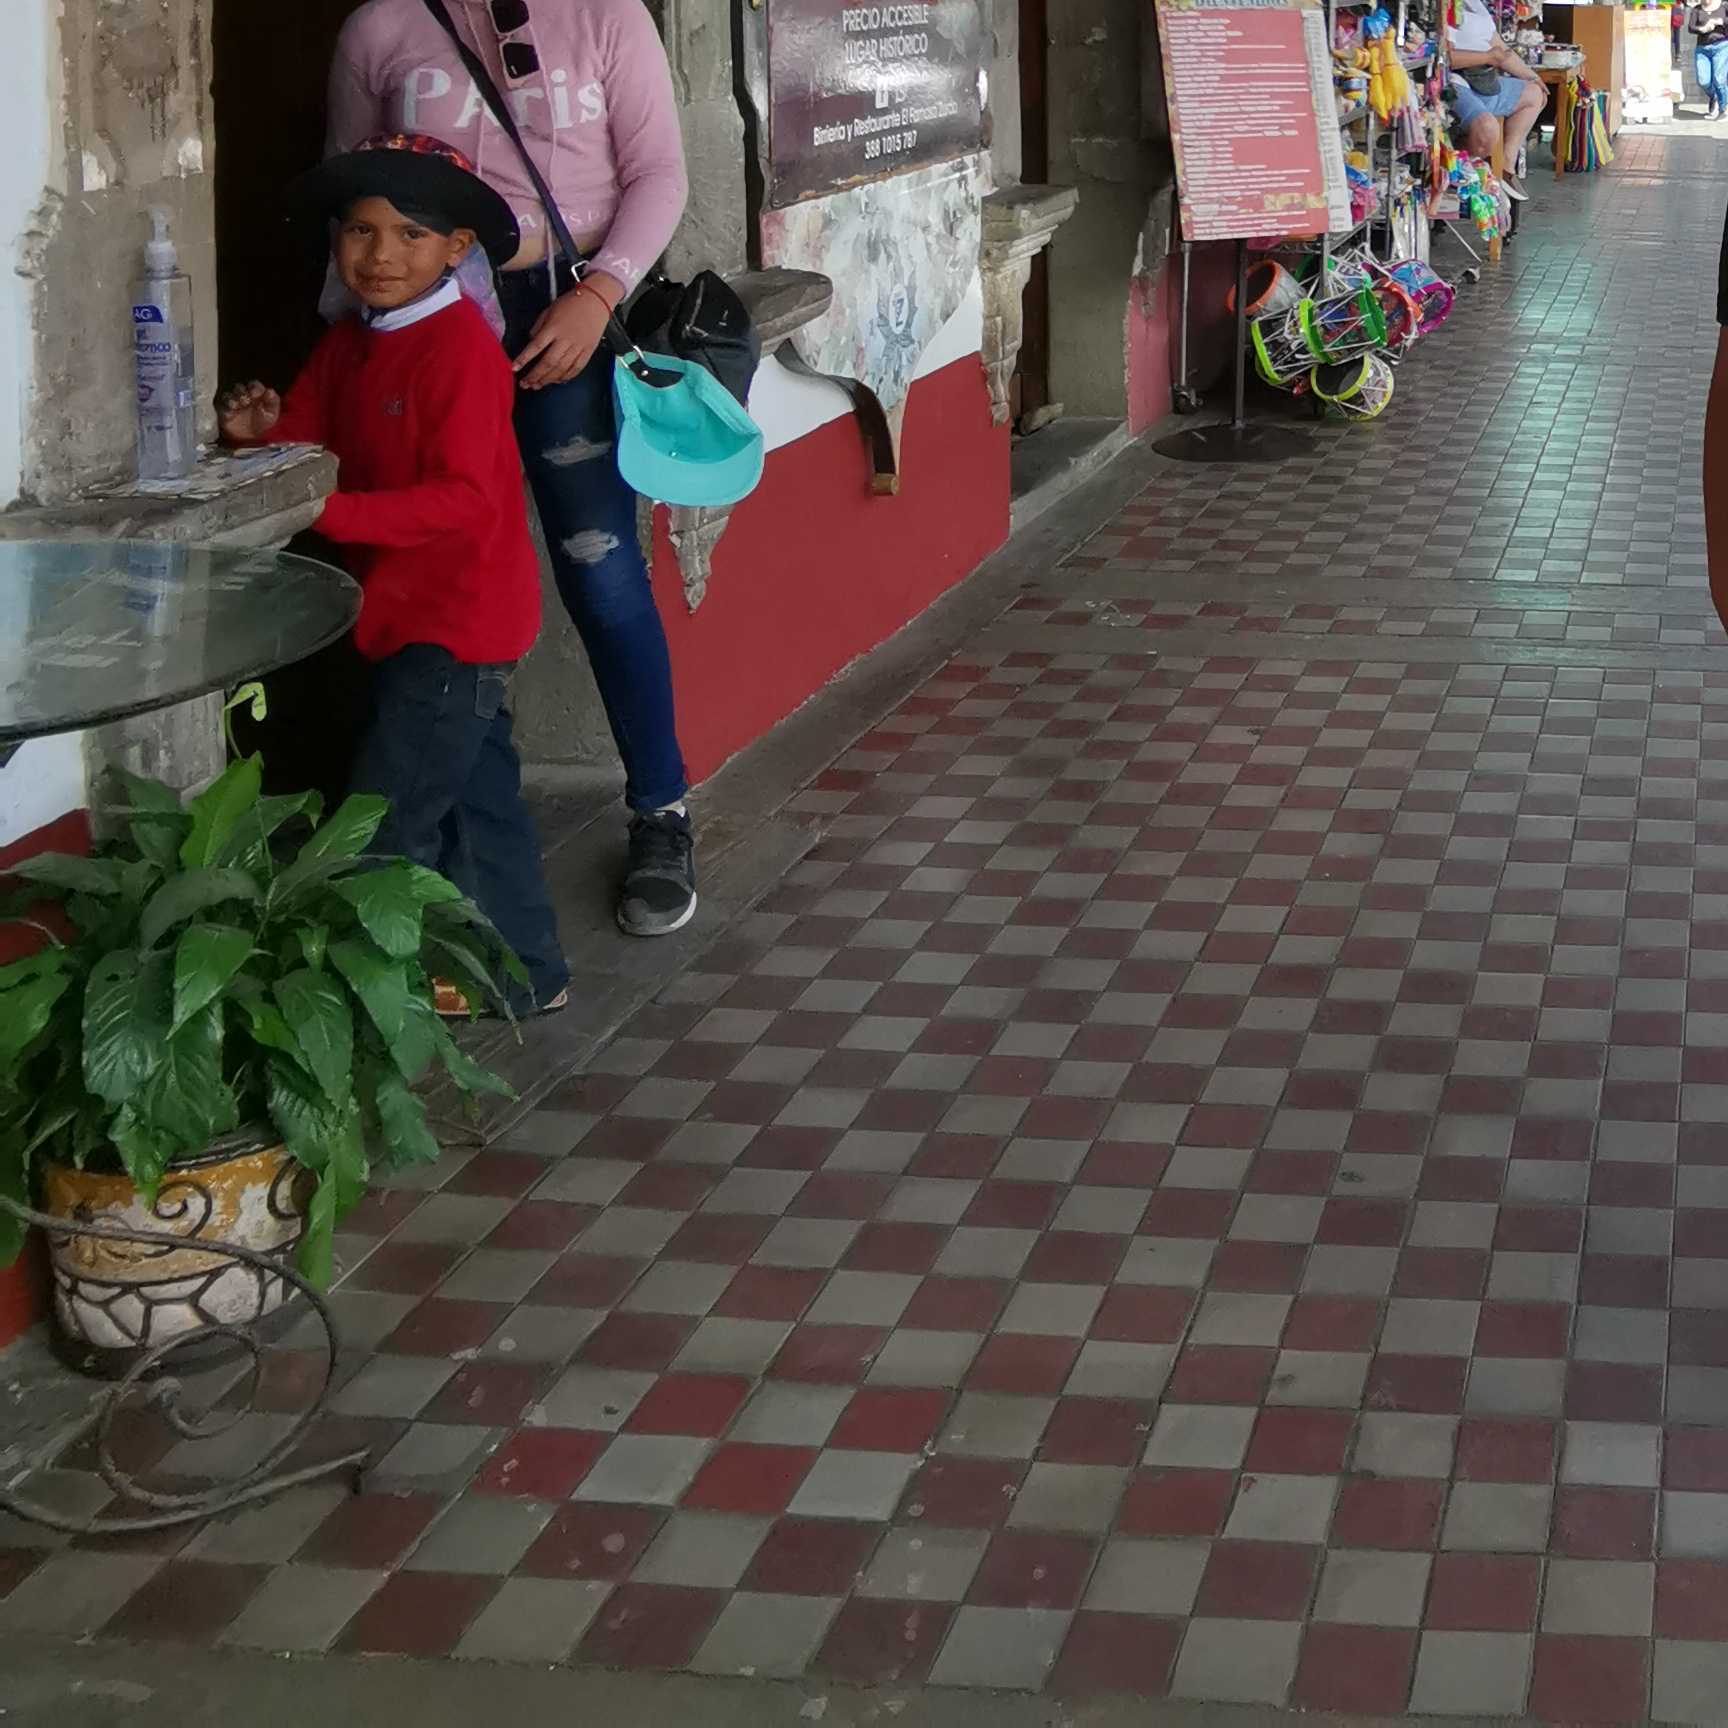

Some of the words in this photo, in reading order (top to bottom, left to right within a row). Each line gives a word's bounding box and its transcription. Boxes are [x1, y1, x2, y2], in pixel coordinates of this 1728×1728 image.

[842, 7, 880, 33] PRECIO
[881, 4, 930, 28] ACCESIBLE
[844, 39, 878, 63] LUGAR
[879, 30, 929, 59] HISTÓRICO
[847, 124, 854, 142] y
[854, 111, 901, 137] Restaurante
